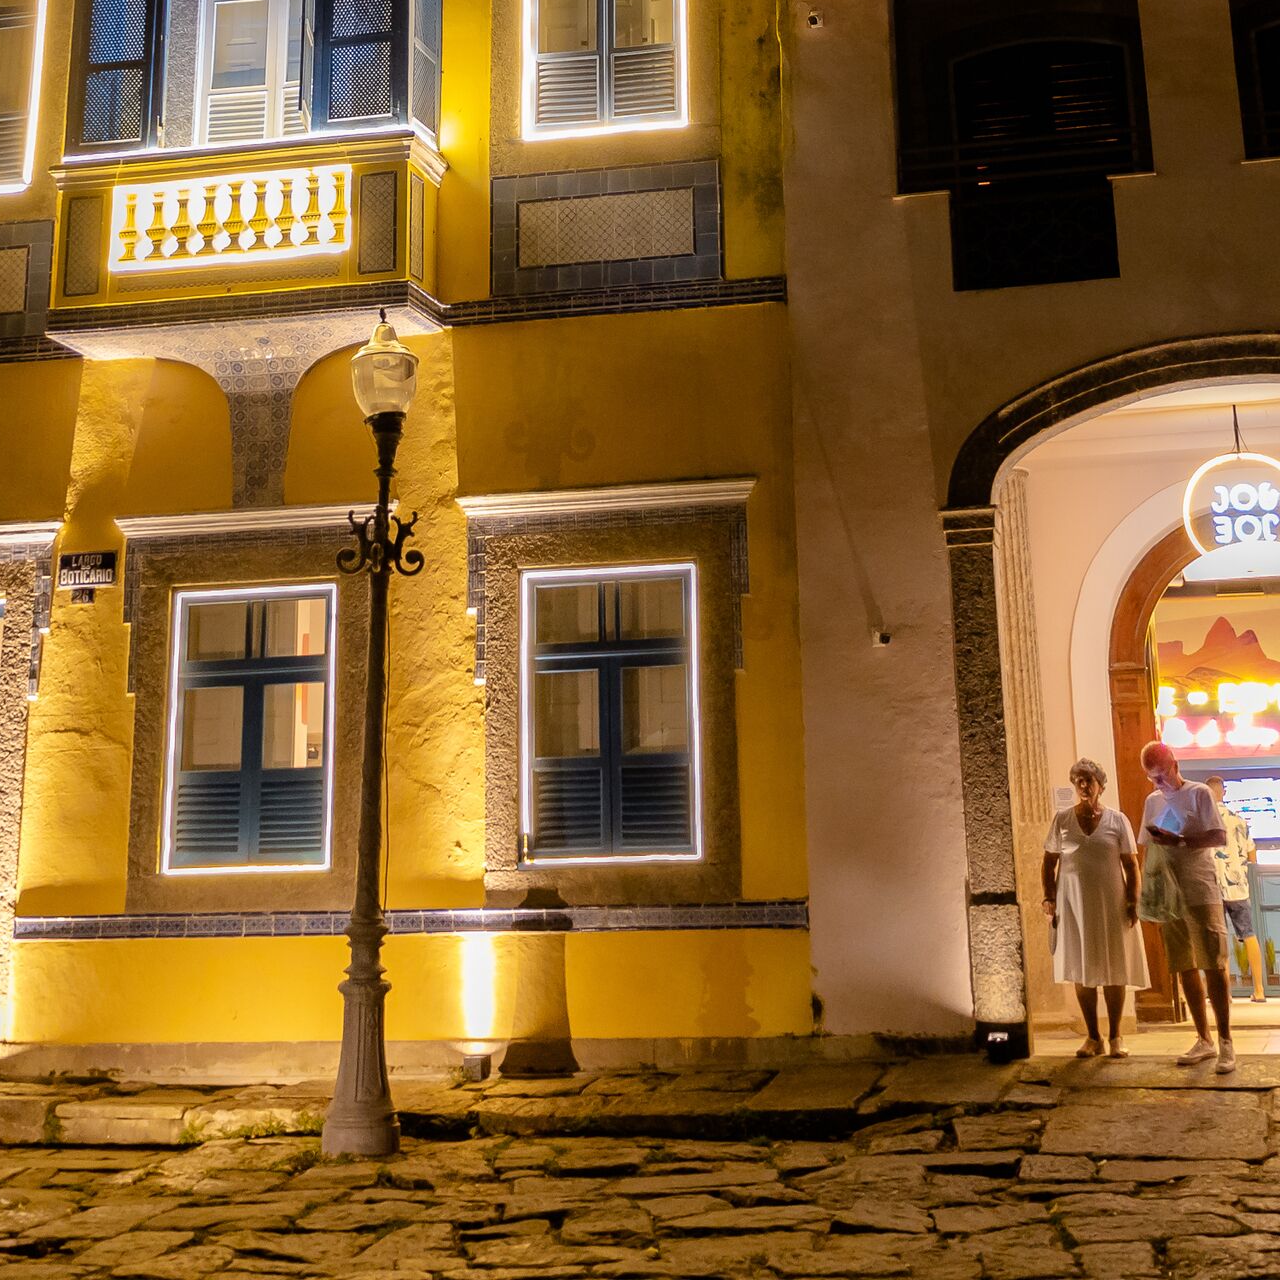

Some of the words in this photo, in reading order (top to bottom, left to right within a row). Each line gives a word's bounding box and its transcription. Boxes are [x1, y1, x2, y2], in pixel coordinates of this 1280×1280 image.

[72, 555, 102, 567] LARGO
[60, 568, 113, 585] BOTICARIO
[72, 589, 90, 603] 26
